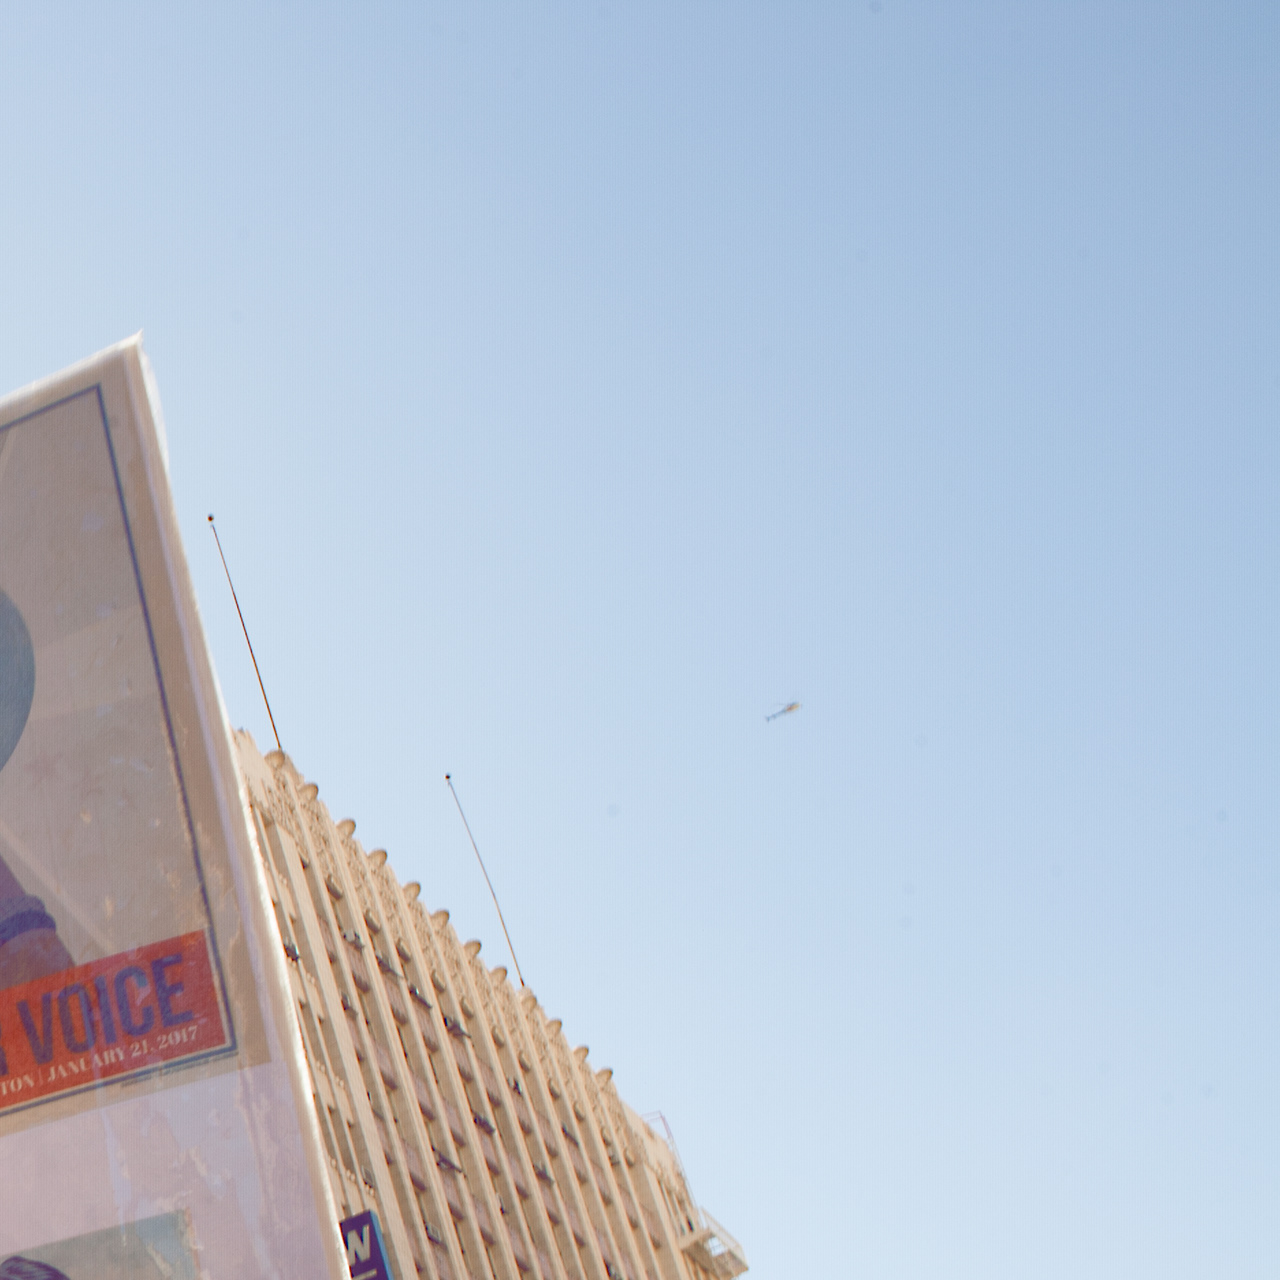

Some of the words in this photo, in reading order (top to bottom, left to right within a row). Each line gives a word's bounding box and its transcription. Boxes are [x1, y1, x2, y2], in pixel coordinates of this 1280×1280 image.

[17, 952, 195, 1066] VOICE
[47, 1045, 128, 1084] JANUARY
[156, 1025, 200, 1054] 2017
